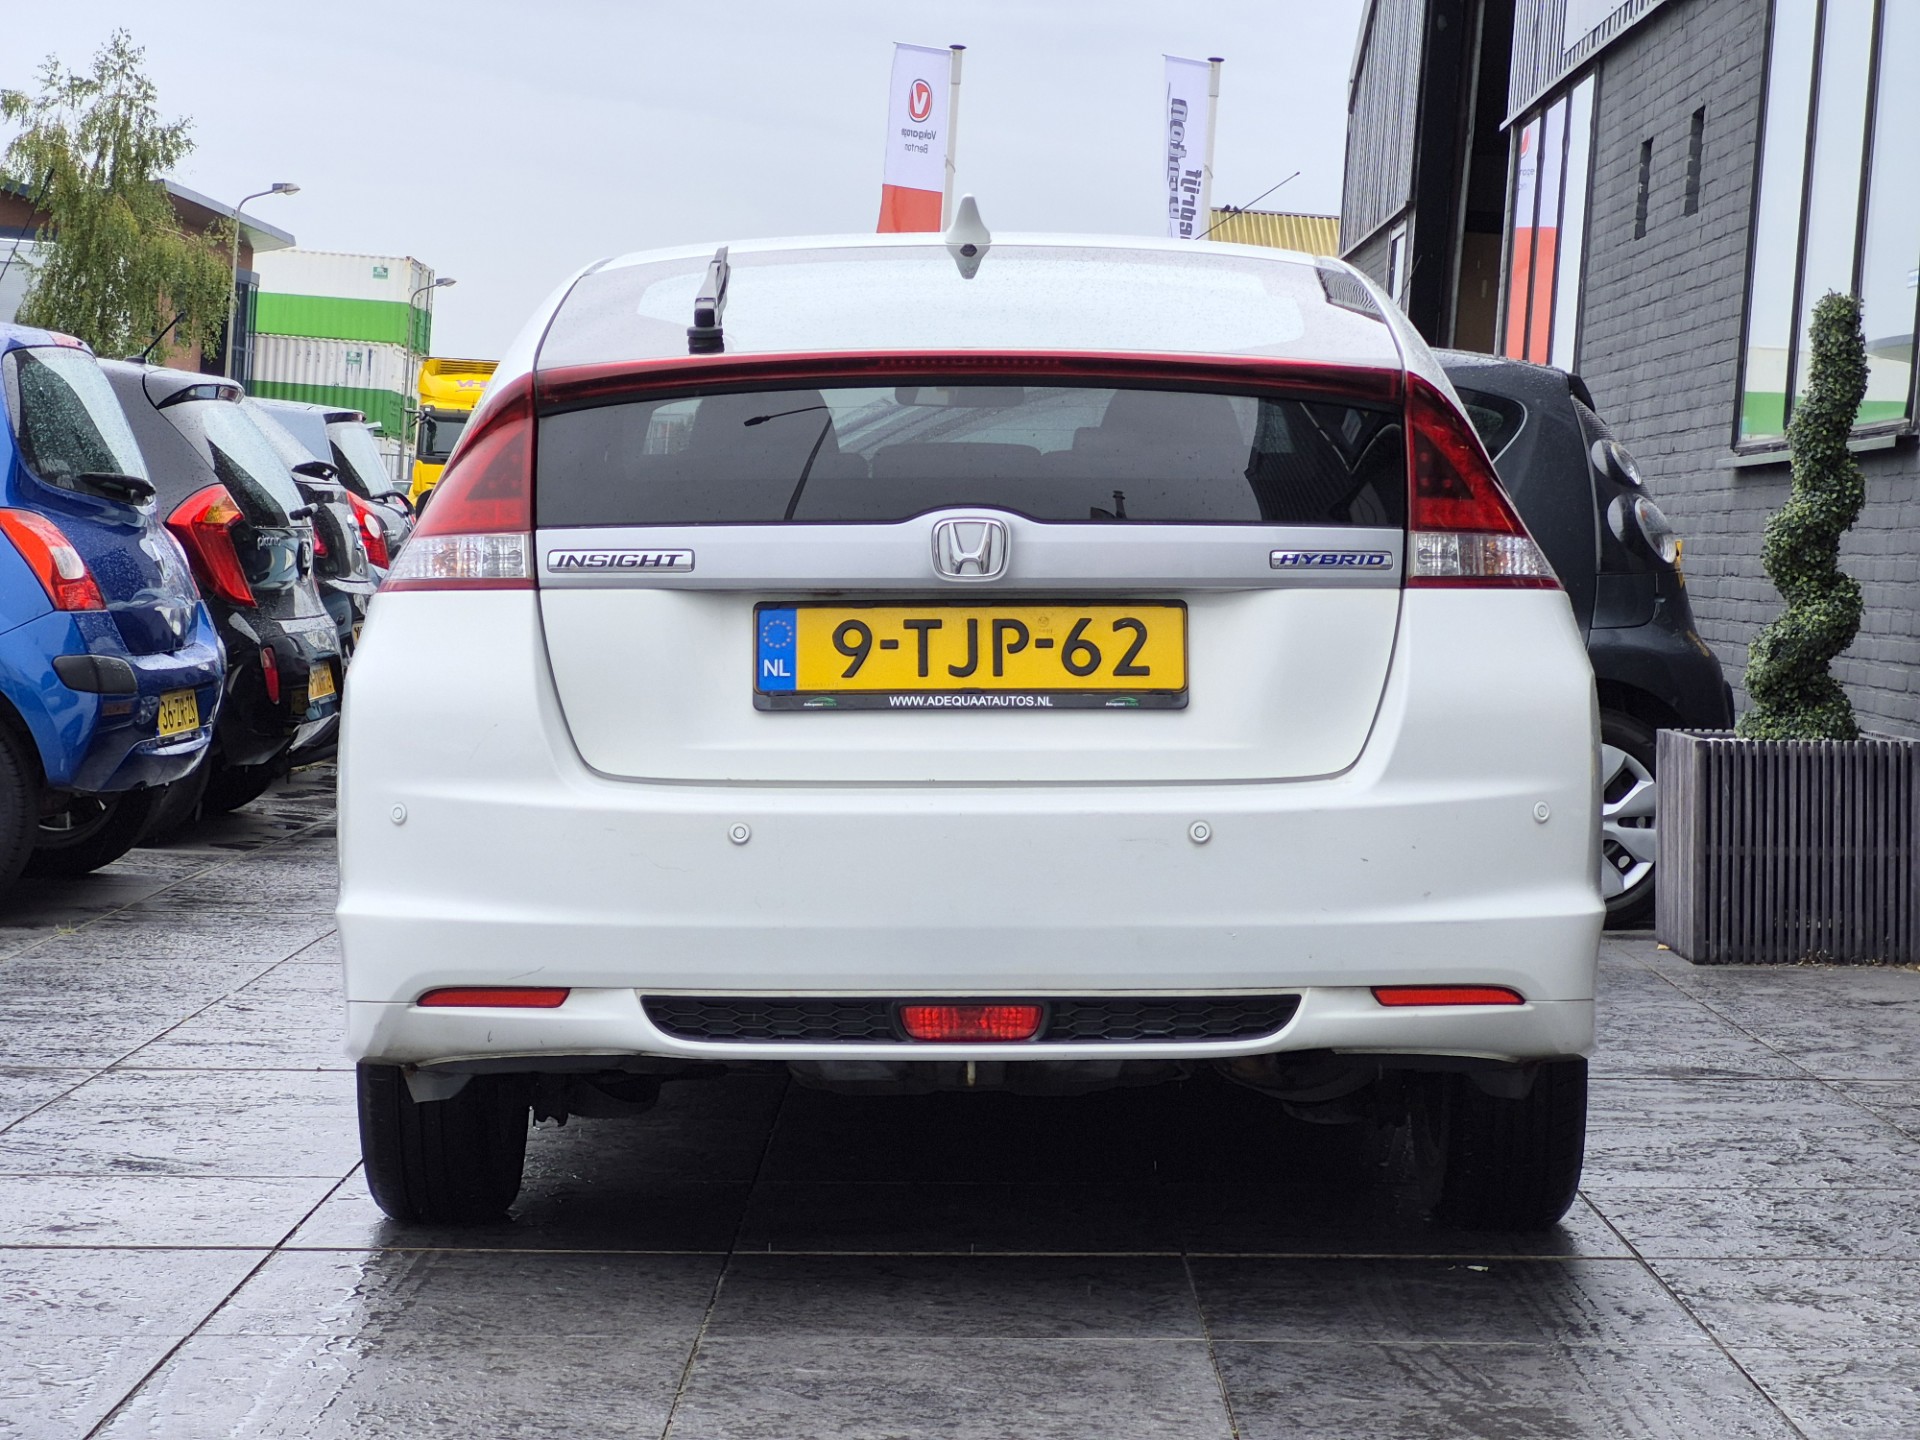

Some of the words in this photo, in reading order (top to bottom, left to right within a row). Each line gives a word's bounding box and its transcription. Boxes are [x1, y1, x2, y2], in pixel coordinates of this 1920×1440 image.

[556, 554, 684, 568] INSIGHT
[1279, 554, 1385, 565] HYBRID
[832, 617, 1150, 679] 9-TJP-62
[763, 659, 790, 677] NL
[889, 696, 1053, 706] WWW.ADEQUAATAUTOS.NL
